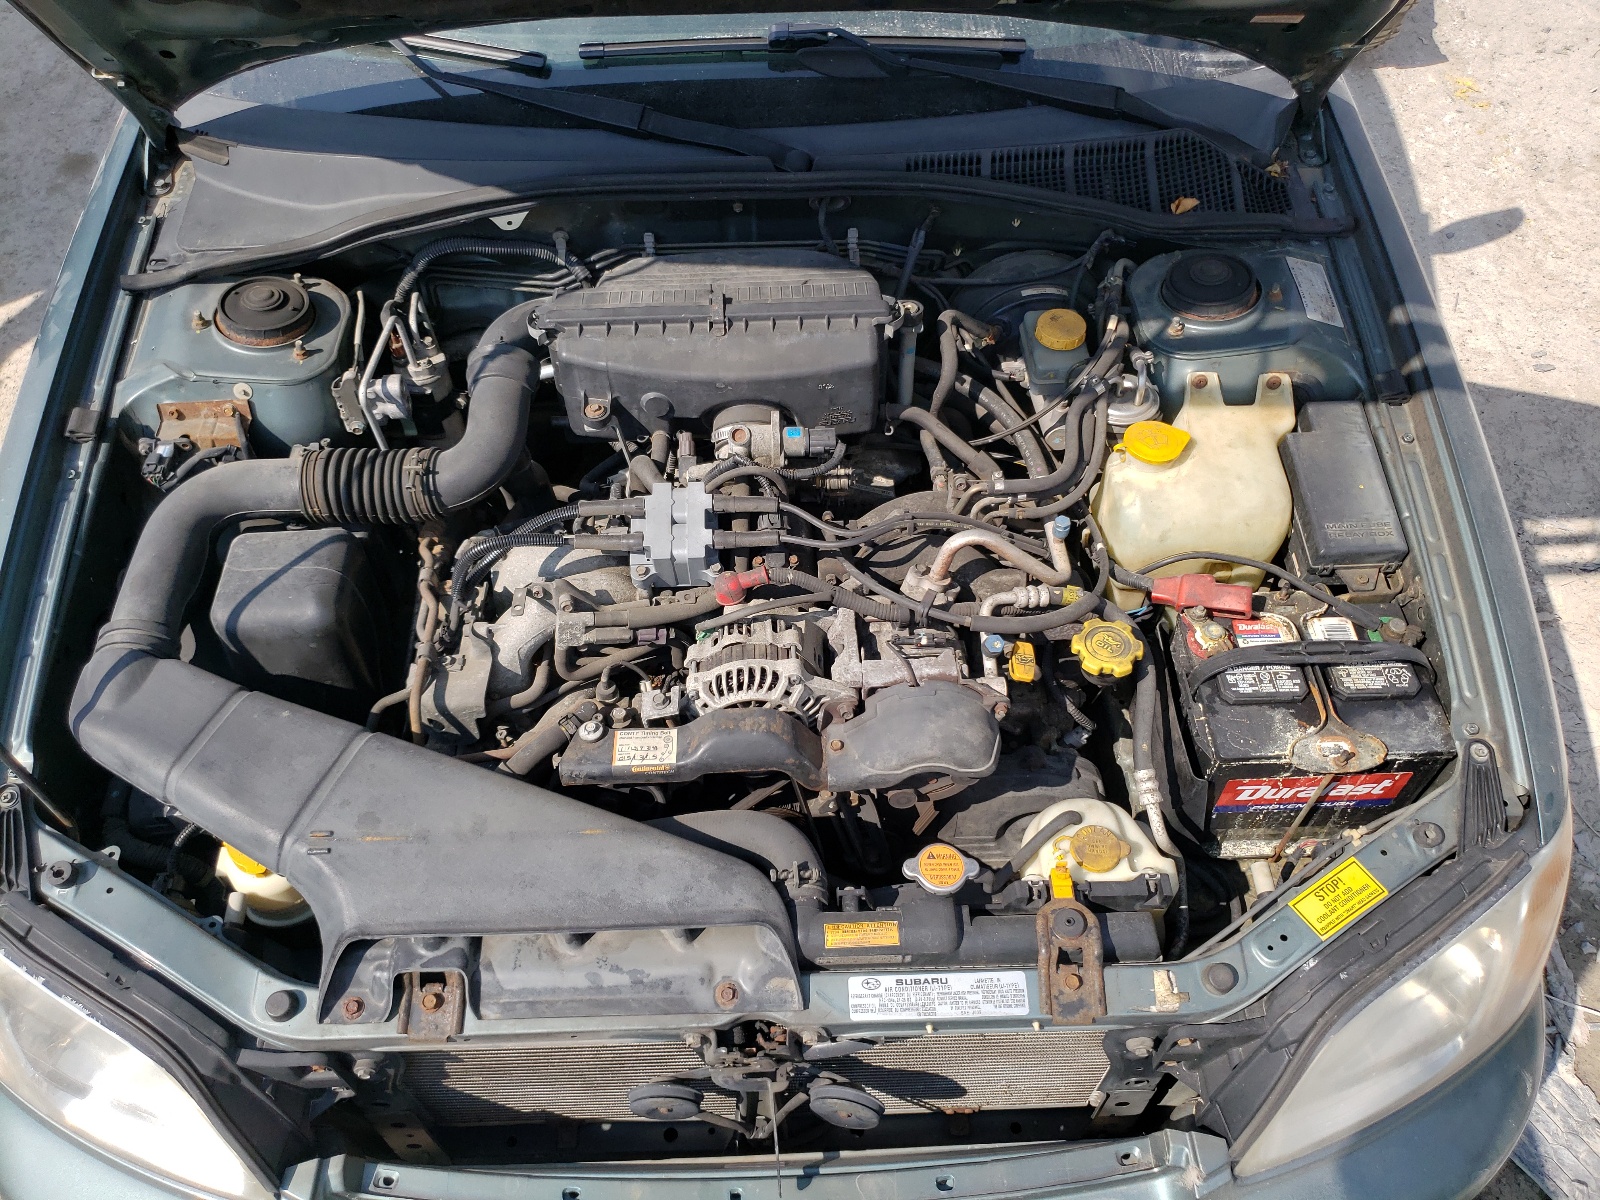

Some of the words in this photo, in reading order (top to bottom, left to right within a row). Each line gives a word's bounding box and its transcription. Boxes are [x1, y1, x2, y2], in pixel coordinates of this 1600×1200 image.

[1325, 522, 1358, 530] MAIN
[1328, 531, 1365, 539] RELAY
[1369, 530, 1395, 538] BOX
[1236, 623, 1276, 631] Duralast
[1095, 640, 1114, 653] OIL
[1235, 779, 1394, 801] Duralast
[1250, 803, 1307, 811] PROVEN
[1314, 876, 1346, 902] STOP!
[1323, 901, 1333, 910] DO
[1331, 894, 1343, 905] NOT
[1341, 886, 1354, 896] ADD
[1316, 905, 1340, 924] COOLANT
[1338, 883, 1371, 908] CONDITIONER
[895, 978, 949, 986] SUBARU
[894, 985, 929, 993] CONDITIONER
